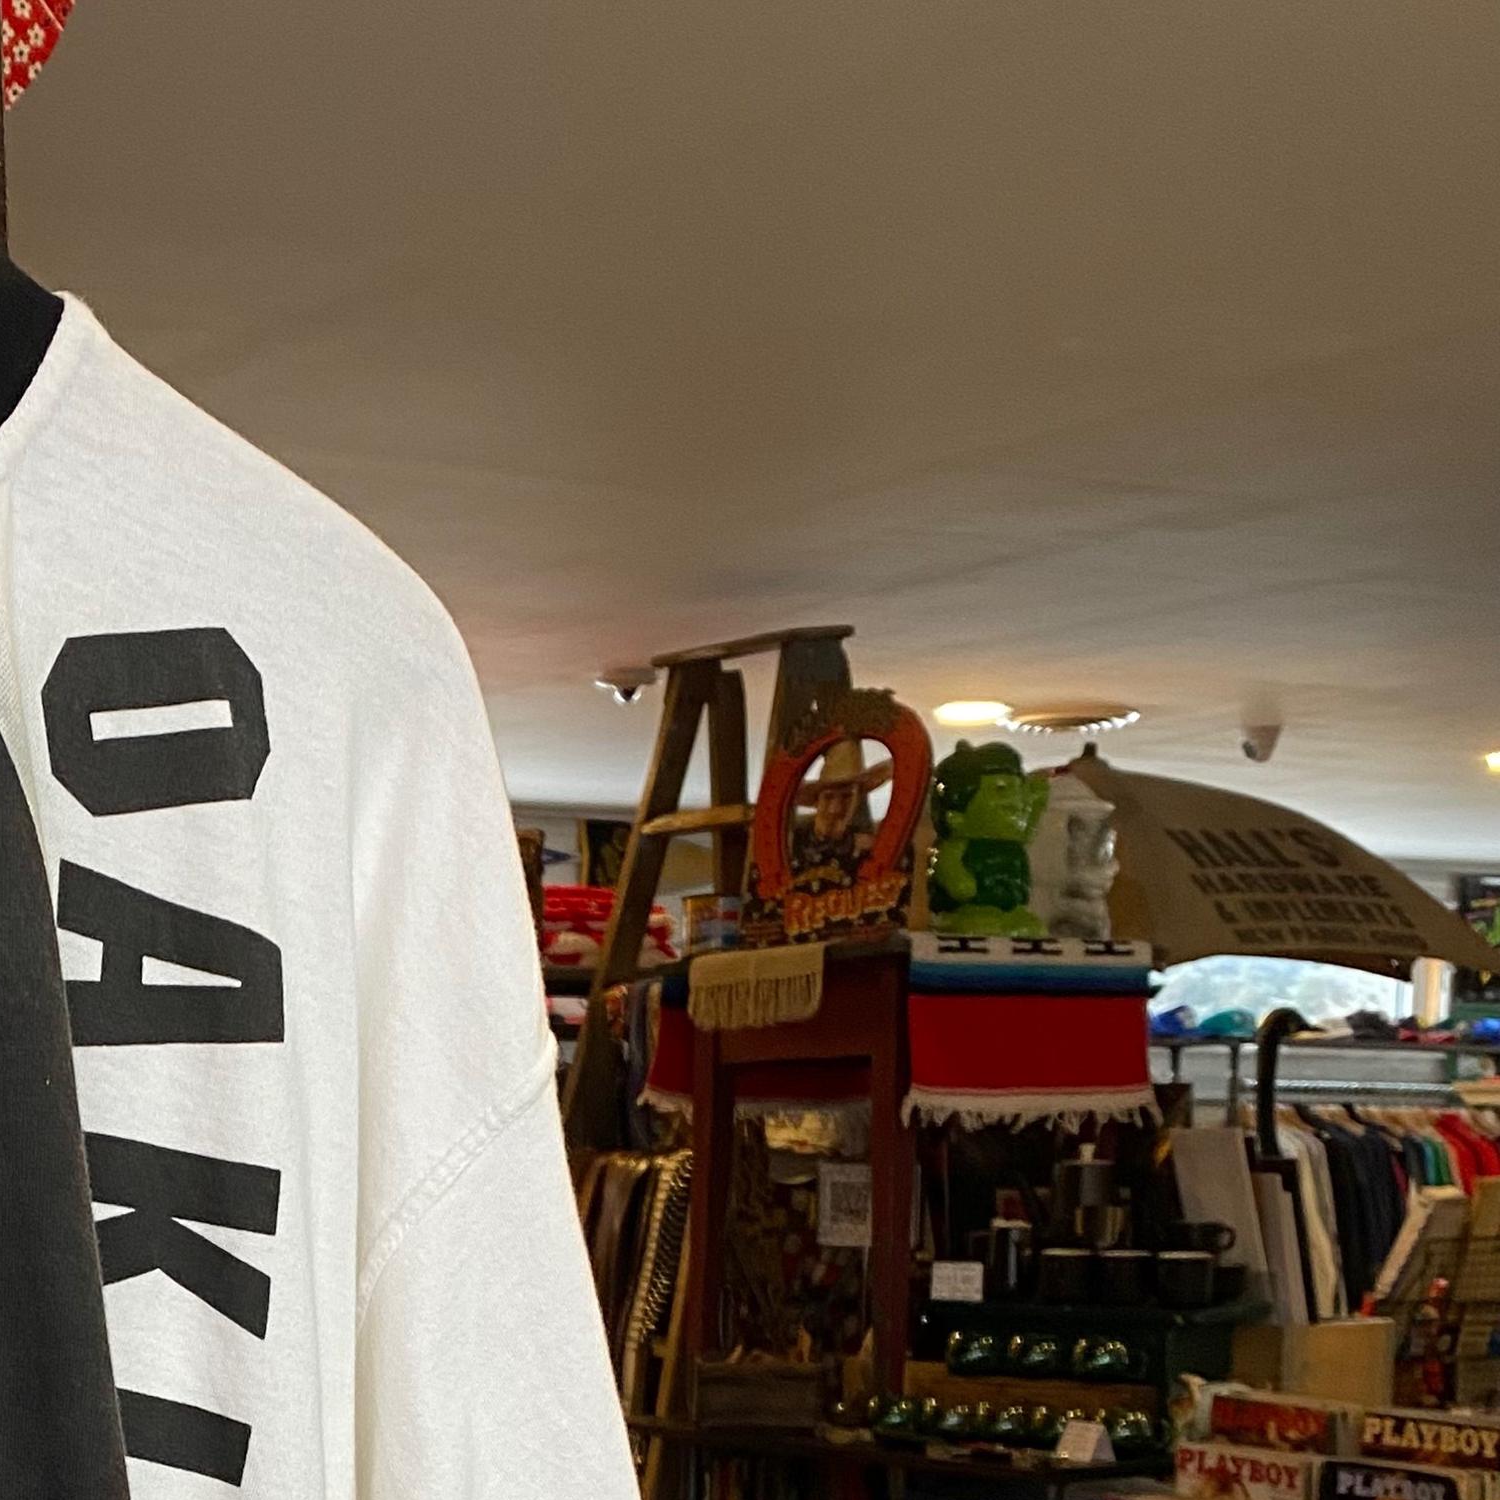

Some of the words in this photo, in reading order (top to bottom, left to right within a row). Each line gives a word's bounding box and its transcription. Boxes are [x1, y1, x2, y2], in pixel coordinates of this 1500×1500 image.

[1190, 872, 1392, 898] HARDWARE
[1363, 1416, 1500, 1459] PLAYBOY
[1177, 1447, 1299, 1489] PLAYBOY
